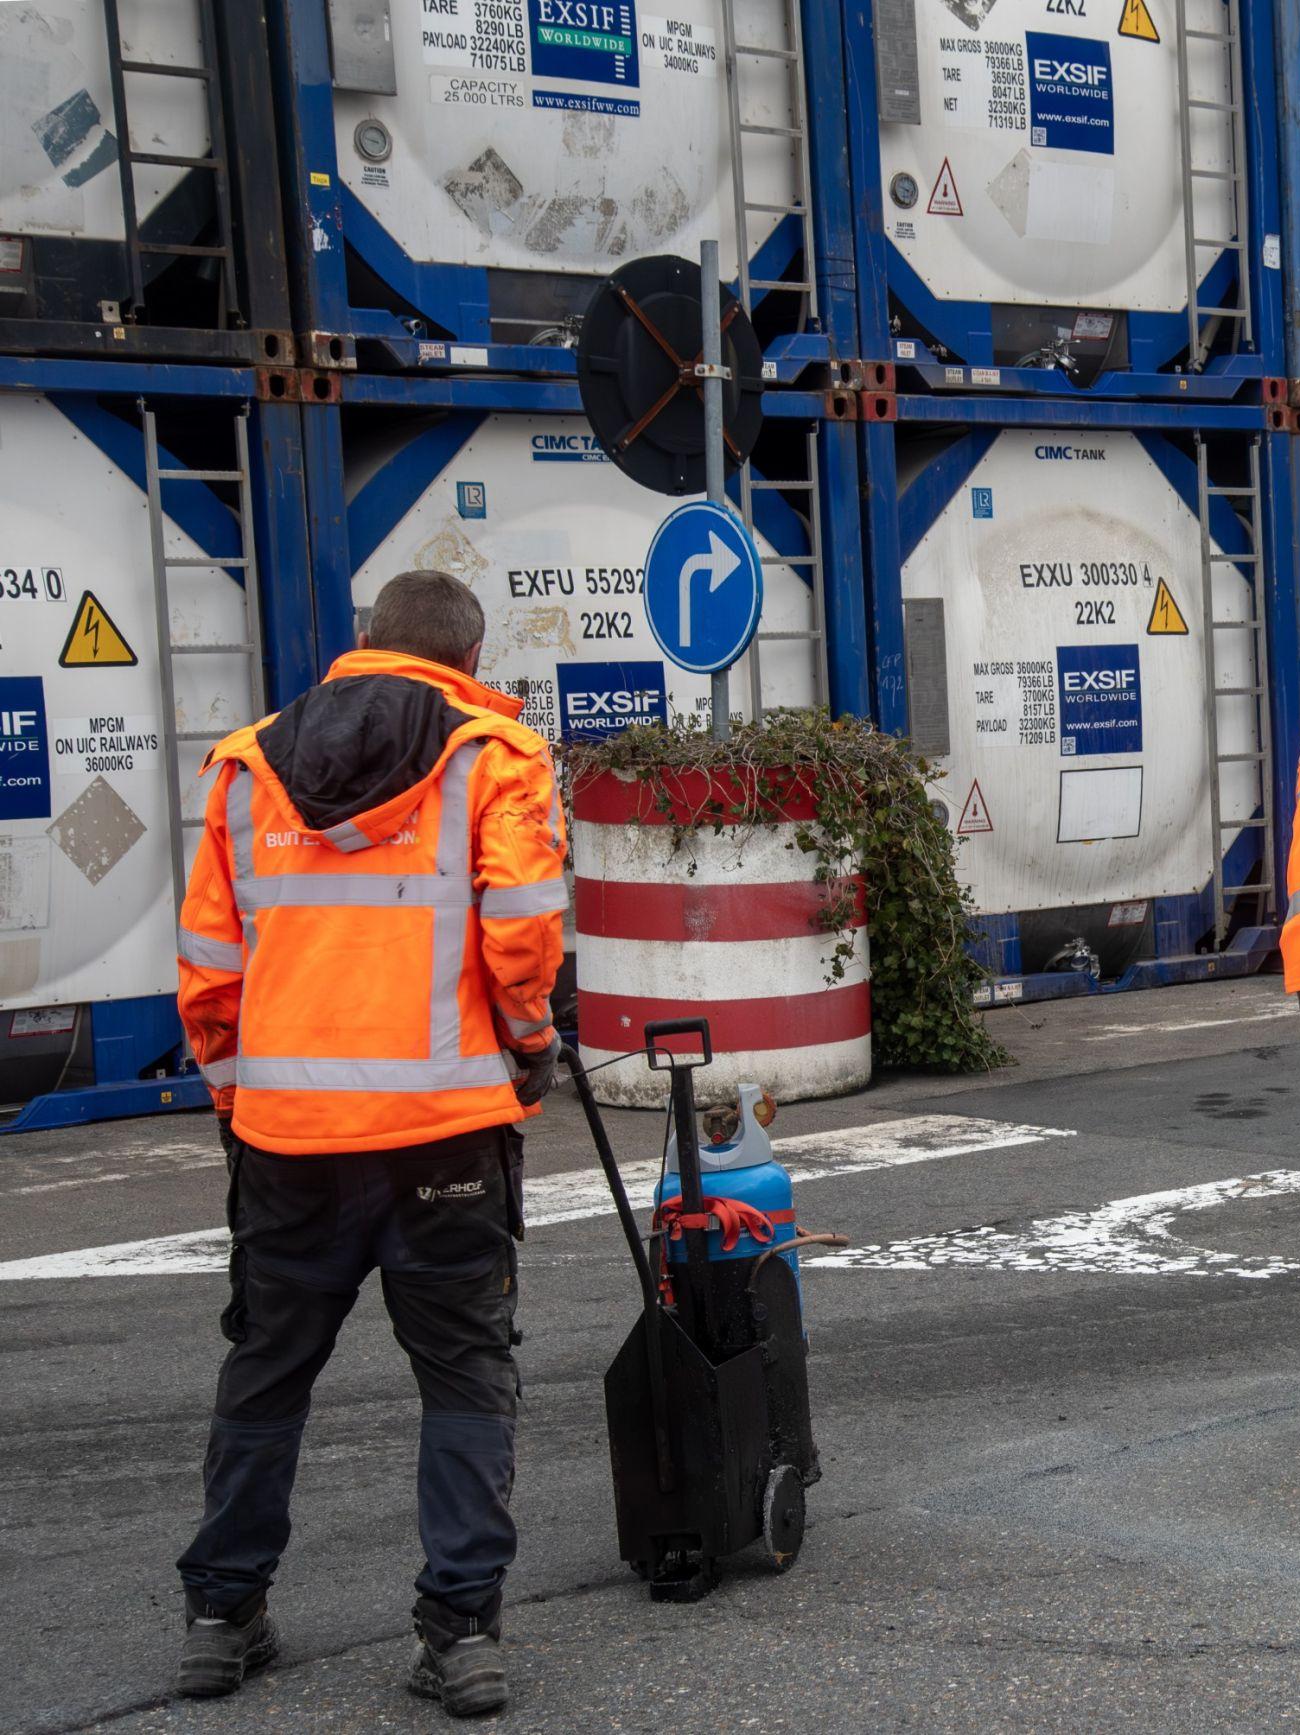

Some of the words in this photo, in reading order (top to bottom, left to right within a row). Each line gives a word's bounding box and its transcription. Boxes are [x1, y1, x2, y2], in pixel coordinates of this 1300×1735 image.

[423, 0, 458, 15] TARE
[474, 2, 523, 22] 3760KG
[538, 0, 614, 30] EXSIF
[667, 20, 692, 37] MPGM
[422, 31, 467, 50] PAYLOAD
[470, 36, 526, 56] 32240KG
[540, 28, 626, 51] WORLDWIDE
[642, 34, 655, 49] ON
[660, 38, 674, 52] UIC
[677, 40, 716, 60] RAILWAYS
[940, 38, 955, 51] MAX
[958, 40, 982, 54] GROSS
[984, 41, 1023, 56] 36000KG
[664, 55, 699, 74] 34000KG
[1034, 59, 1107, 86] EXSIF
[943, 68, 962, 82] TARE
[992, 71, 1024, 86] 3650KG
[450, 79, 517, 94] CAPACITY
[1036, 83, 1108, 100] WORLDWIDE
[491, 94, 524, 107] LTRS
[534, 95, 640, 117] www.exsifww.com
[944, 98, 958, 111] NET
[988, 100, 1026, 115] 32350KG
[1037, 112, 1109, 128] www.exsif.com
[532, 435, 578, 451] CIMC
[1035, 446, 1073, 460] CIMC
[1074, 448, 1106, 461] TANK
[508, 568, 574, 598] EXFU
[585, 568, 645, 595] 55292
[1020, 563, 1073, 588] EXXU
[1080, 562, 1138, 586] 300330
[46, 569, 62, 600] 0
[1075, 600, 1115, 624] 22K2
[580, 612, 634, 639] 22K2
[974, 663, 989, 676] MAX
[991, 662, 1014, 675] GROSS
[1017, 661, 1053, 675] 36000KG
[1064, 669, 1135, 691] EXSIF
[567, 690, 660, 716] EXSIF
[976, 690, 994, 704] TARE
[1023, 689, 1055, 702] 3700KG
[1065, 692, 1137, 704] WORLDWIDE
[89, 717, 124, 734] MPGM
[569, 715, 660, 730] WORLDWIDE
[976, 719, 1007, 732] PAYLOAD
[1019, 718, 1055, 731] 32300KG
[1066, 719, 1138, 731] www.exsif.com
[56, 738, 72, 754] ON
[77, 736, 96, 753] UIC
[100, 734, 157, 753] RAILWAYS
[85, 755, 133, 772] 36000KG
